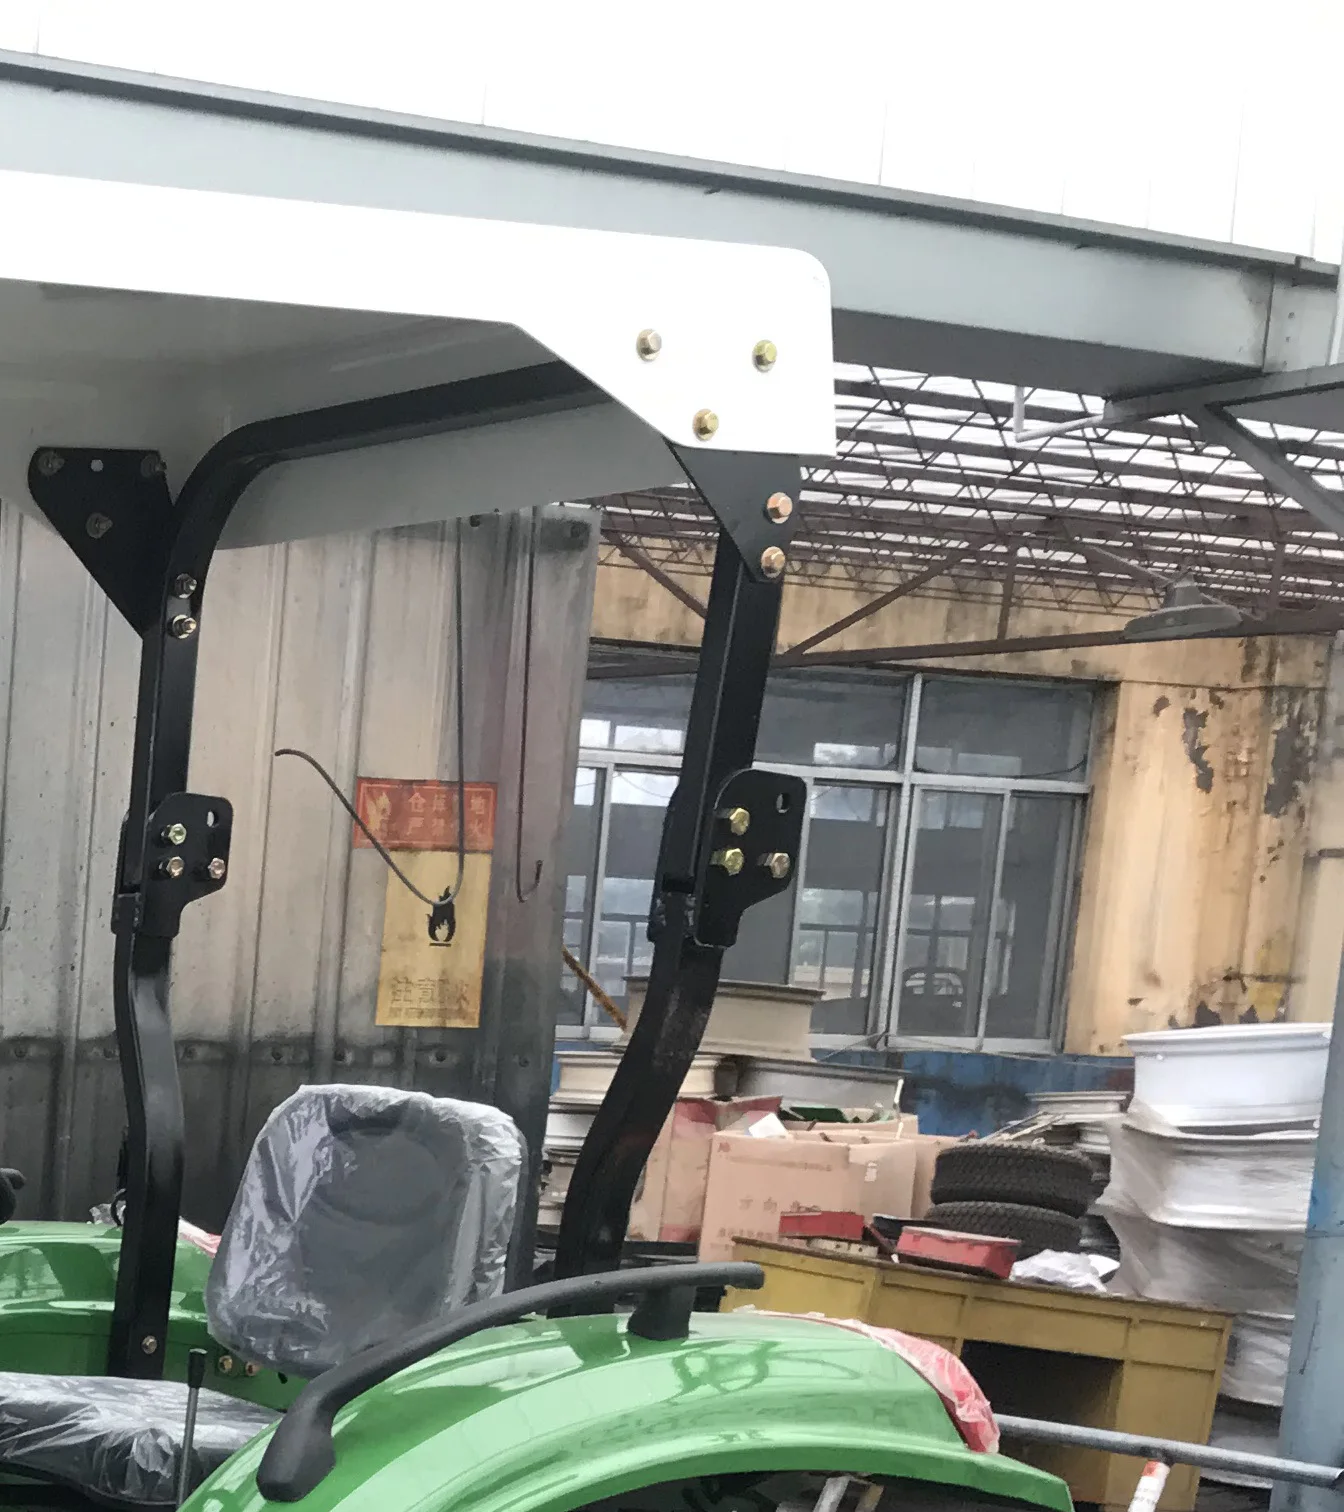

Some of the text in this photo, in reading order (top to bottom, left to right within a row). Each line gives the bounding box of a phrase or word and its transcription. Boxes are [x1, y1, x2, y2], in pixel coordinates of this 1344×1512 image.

[408, 792, 486, 815] 仓库地
[406, 816, 485, 838] 严禁火
